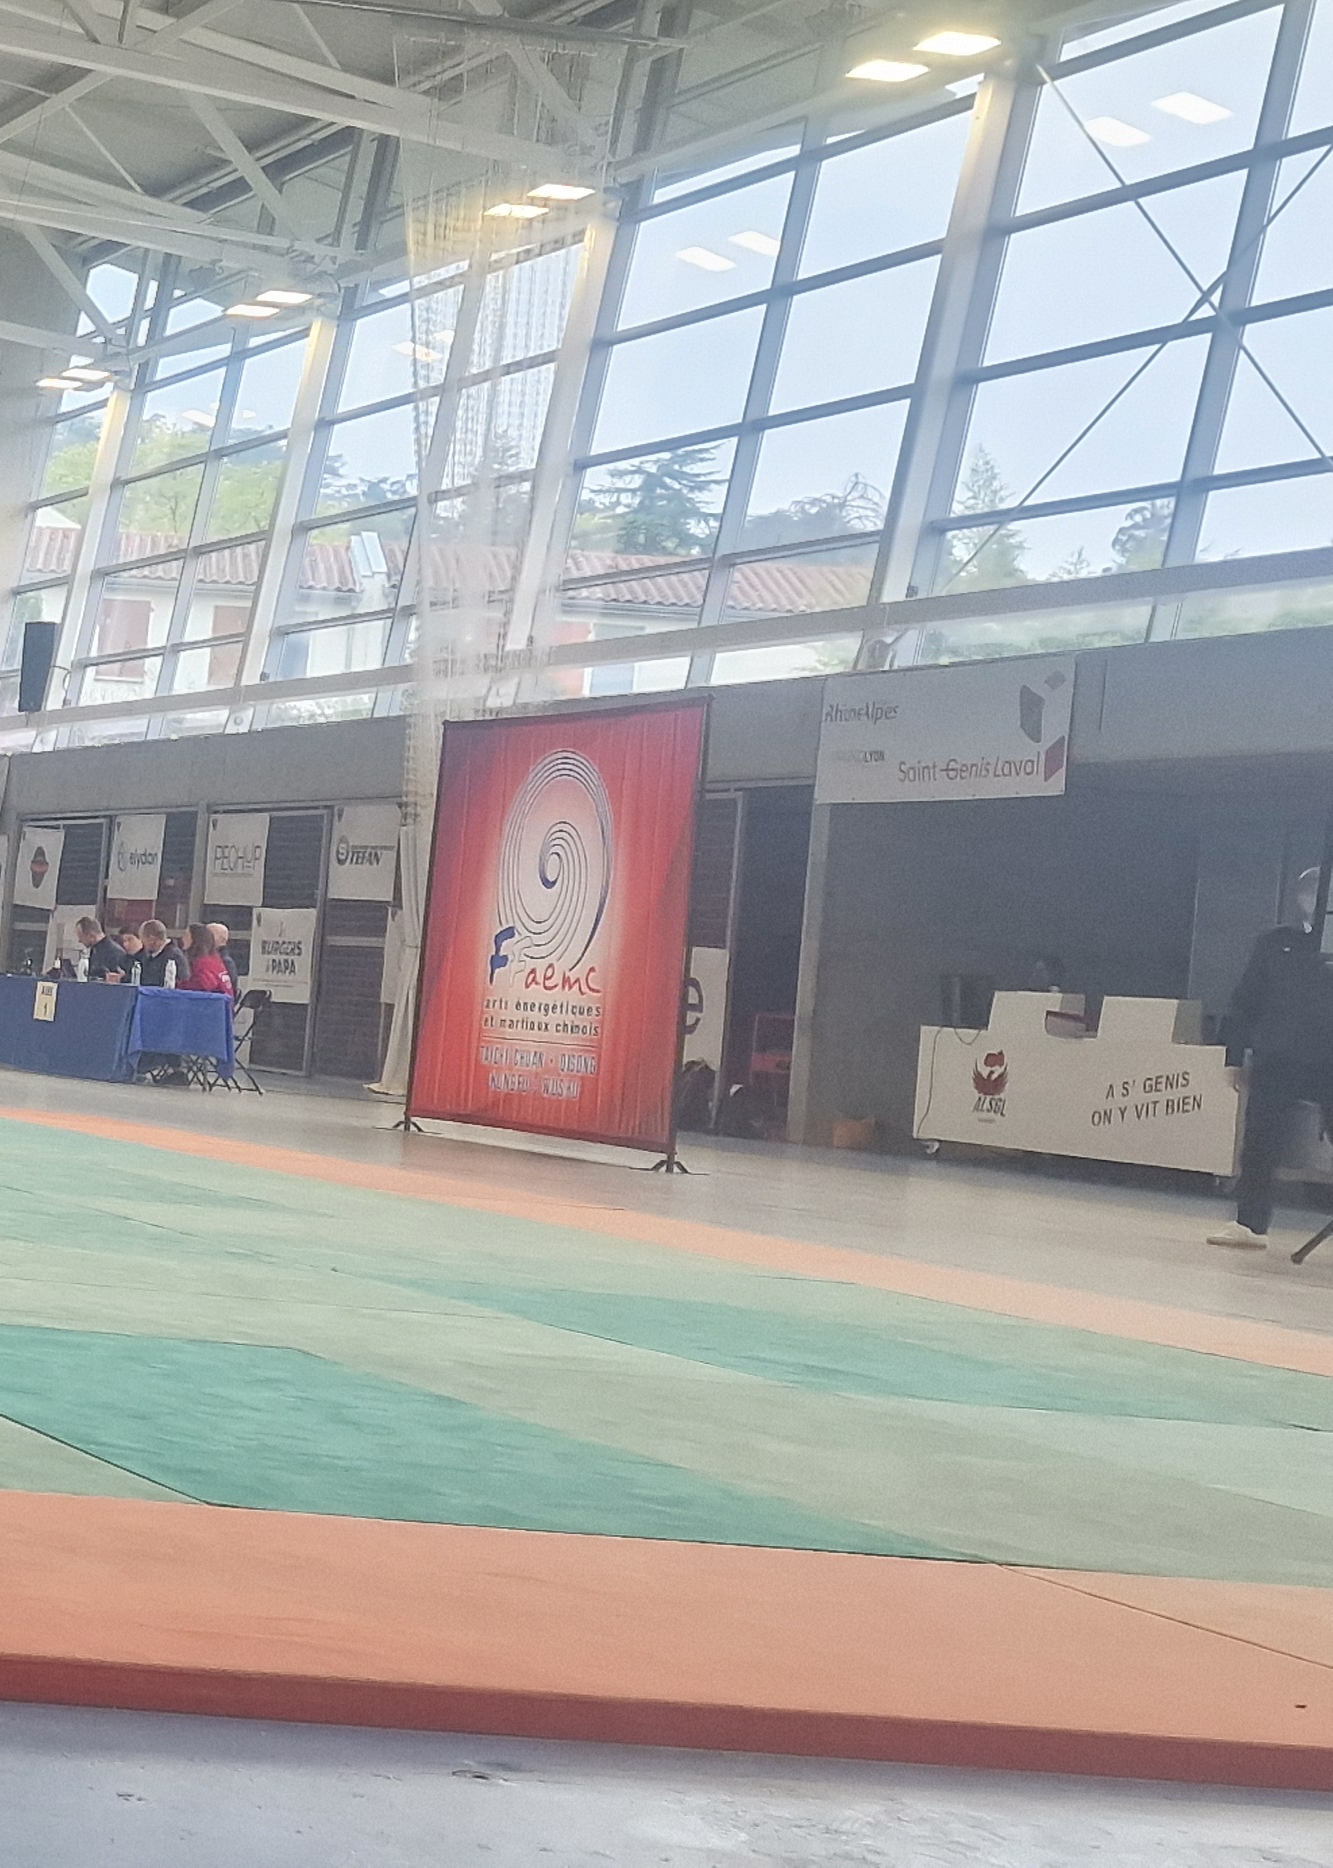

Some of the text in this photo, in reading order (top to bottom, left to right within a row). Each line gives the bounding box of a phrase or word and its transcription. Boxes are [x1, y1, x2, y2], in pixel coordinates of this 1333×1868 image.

[271, 959, 296, 976] PAPA
[555, 1021, 600, 1037] chinois
[1143, 1071, 1191, 1094] GENIS
[1091, 1094, 1203, 1127] ON Y VIT BIEN
